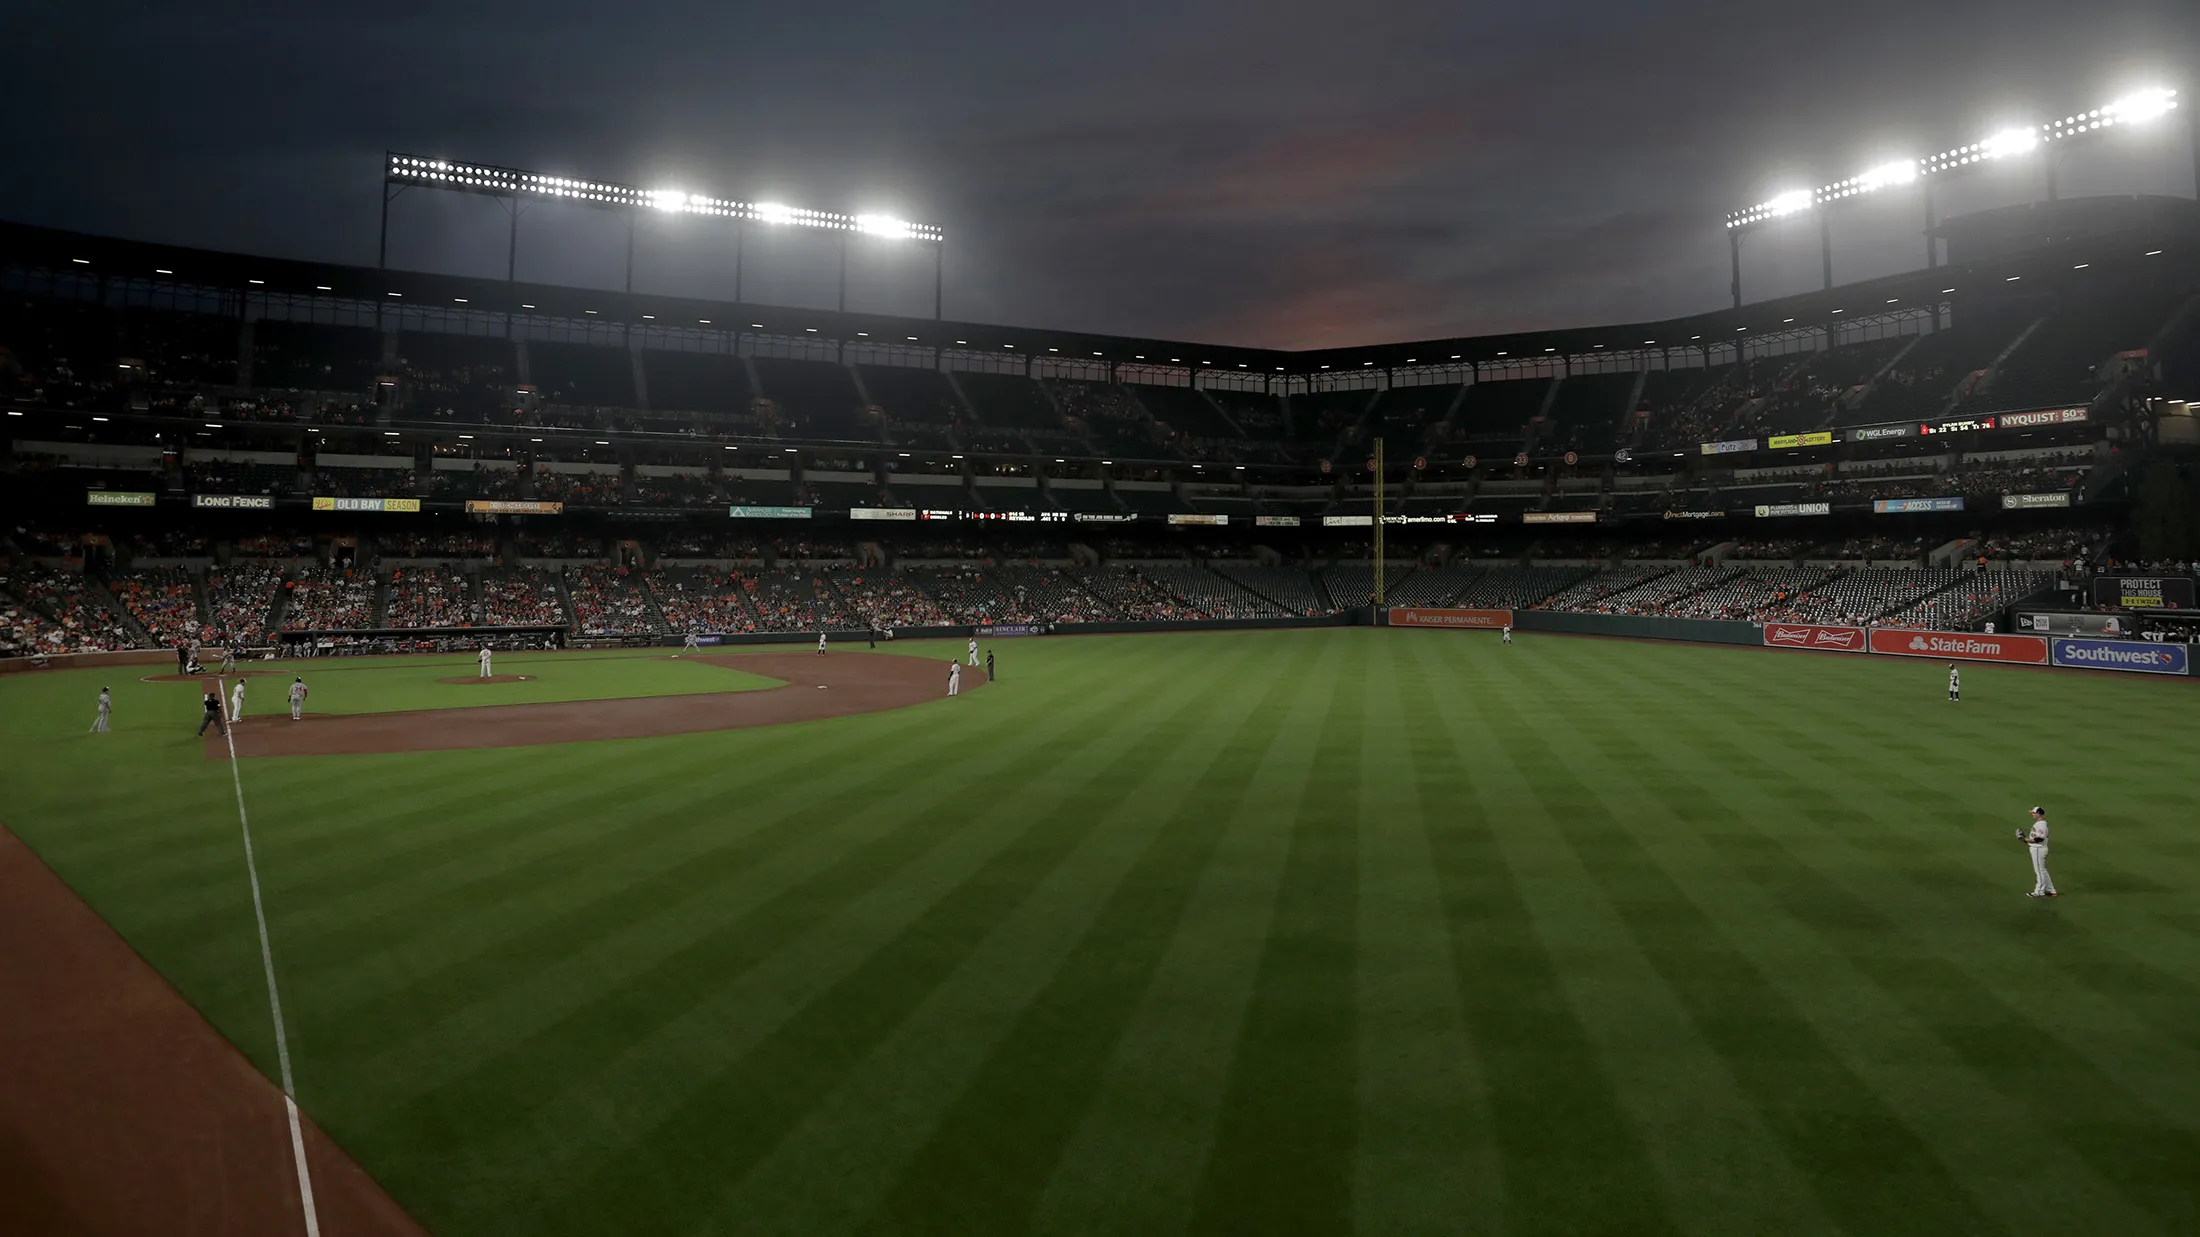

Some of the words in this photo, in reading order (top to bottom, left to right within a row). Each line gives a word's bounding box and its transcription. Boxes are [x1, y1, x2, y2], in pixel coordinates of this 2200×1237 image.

[2002, 413, 2056, 426] NYQUIST
[2063, 410, 2076, 418] 60
[90, 495, 141, 503] Heineken
[197, 496, 230, 506] LONG
[233, 497, 270, 508] FENCE
[2023, 495, 2065, 503] Sheraton
[338, 500, 358, 510] OLD
[361, 500, 381, 511] BAY
[387, 502, 417, 511] SEASON
[1799, 503, 1830, 513] UNION
[2120, 579, 2161, 589] PROTECT
[2121, 589, 2137, 597] THIS
[1444, 616, 1493, 625] PERMANENTE
[1778, 631, 1807, 640] Budweiser
[1819, 633, 1851, 643] Budweiser
[1930, 637, 1965, 654] State
[1966, 640, 2001, 655] Farm
[2065, 645, 2159, 665] Southwest
